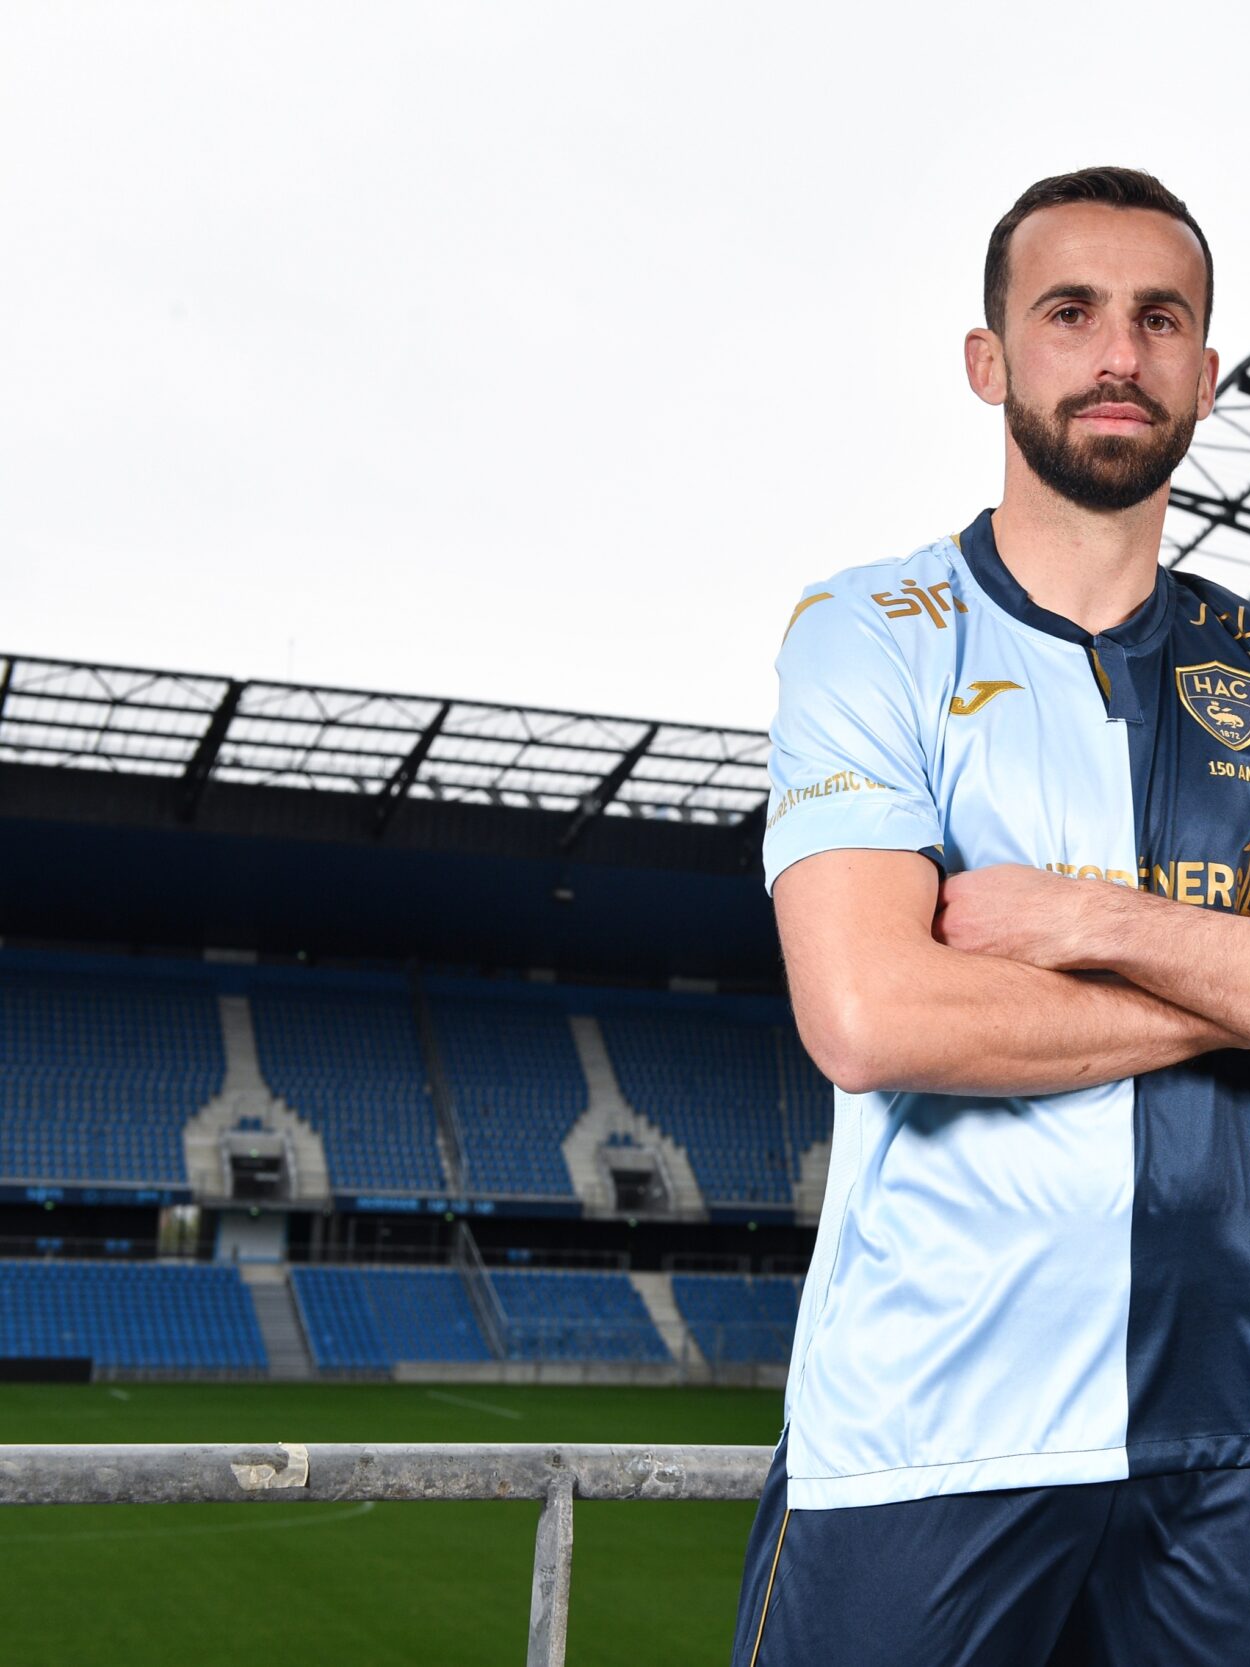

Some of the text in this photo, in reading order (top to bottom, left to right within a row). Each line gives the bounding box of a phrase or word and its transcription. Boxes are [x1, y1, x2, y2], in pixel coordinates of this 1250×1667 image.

[1193, 675, 1248, 700] HAC
[1219, 728, 1241, 741] 1872
[1208, 760, 1235, 777] 150
[787, 770, 861, 809] ATHLETIC
